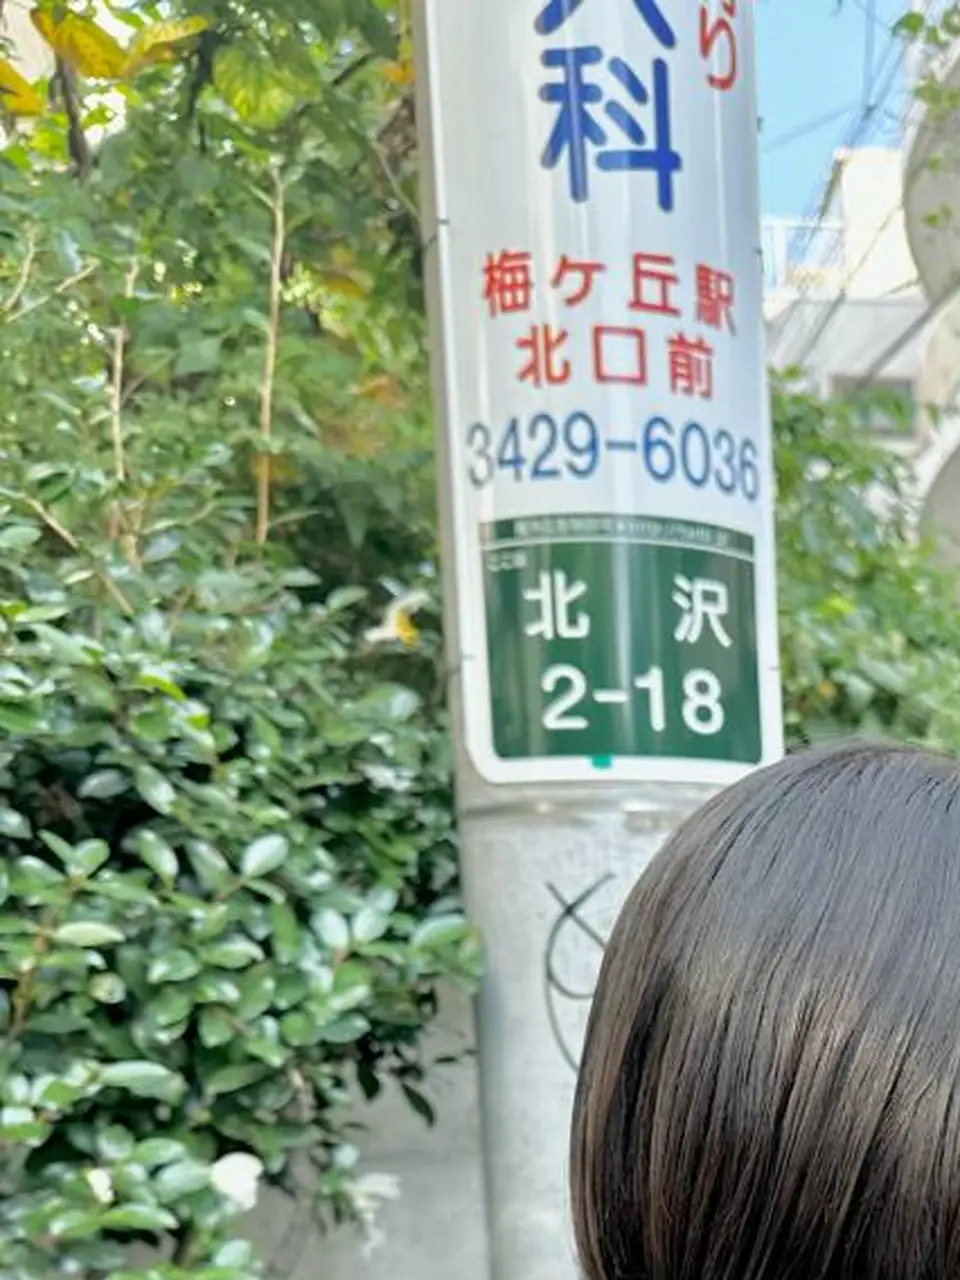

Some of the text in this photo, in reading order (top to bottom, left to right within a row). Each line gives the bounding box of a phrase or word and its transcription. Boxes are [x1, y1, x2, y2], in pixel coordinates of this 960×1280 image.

[515, 323, 714, 399] 北口前
[466, 410, 760, 502] 3429-6036
[522, 568, 733, 648] 北沢
[540, 664, 726, 736] 2-18
